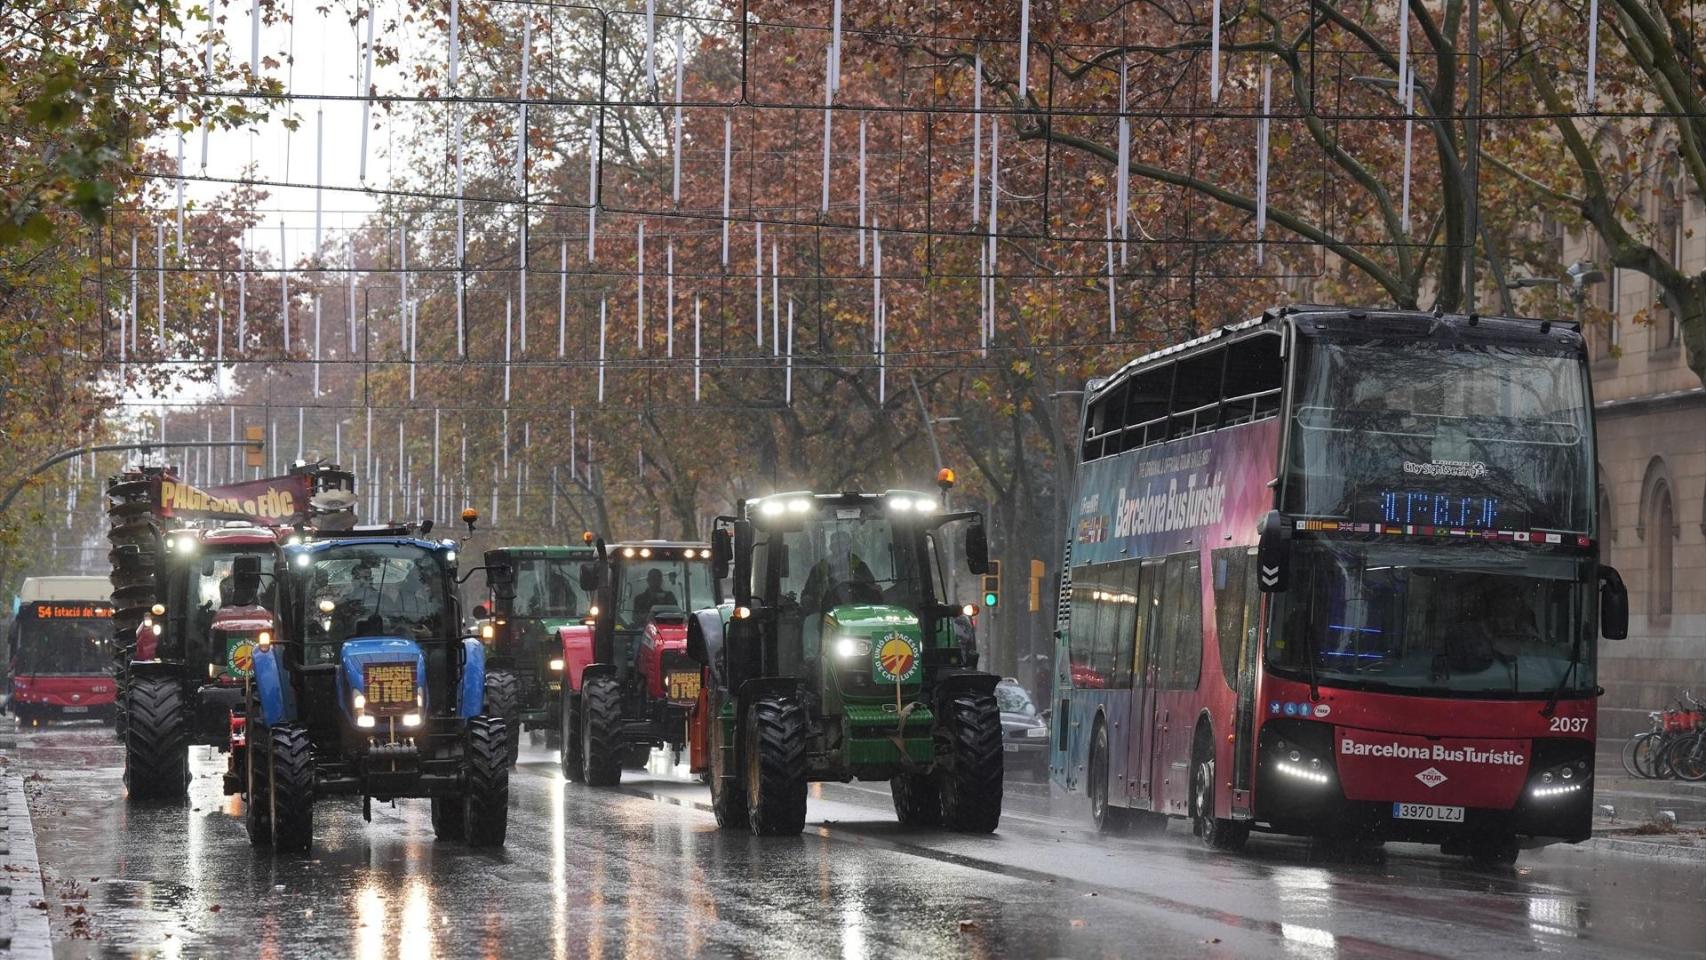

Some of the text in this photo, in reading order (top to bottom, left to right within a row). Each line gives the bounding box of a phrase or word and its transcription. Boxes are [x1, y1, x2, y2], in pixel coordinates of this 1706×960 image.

[1114, 483, 1167, 538] Barcelona
[38, 606, 52, 618] 54
[54, 607, 81, 617] Estació
[82, 607, 94, 617] del
[882, 660, 919, 681] CATLUNYA
[369, 682, 381, 703] O
[1549, 717, 1589, 733] 2037
[1341, 738, 1430, 760] Barcelona
[1402, 805, 1462, 820] 3970 LZJ
